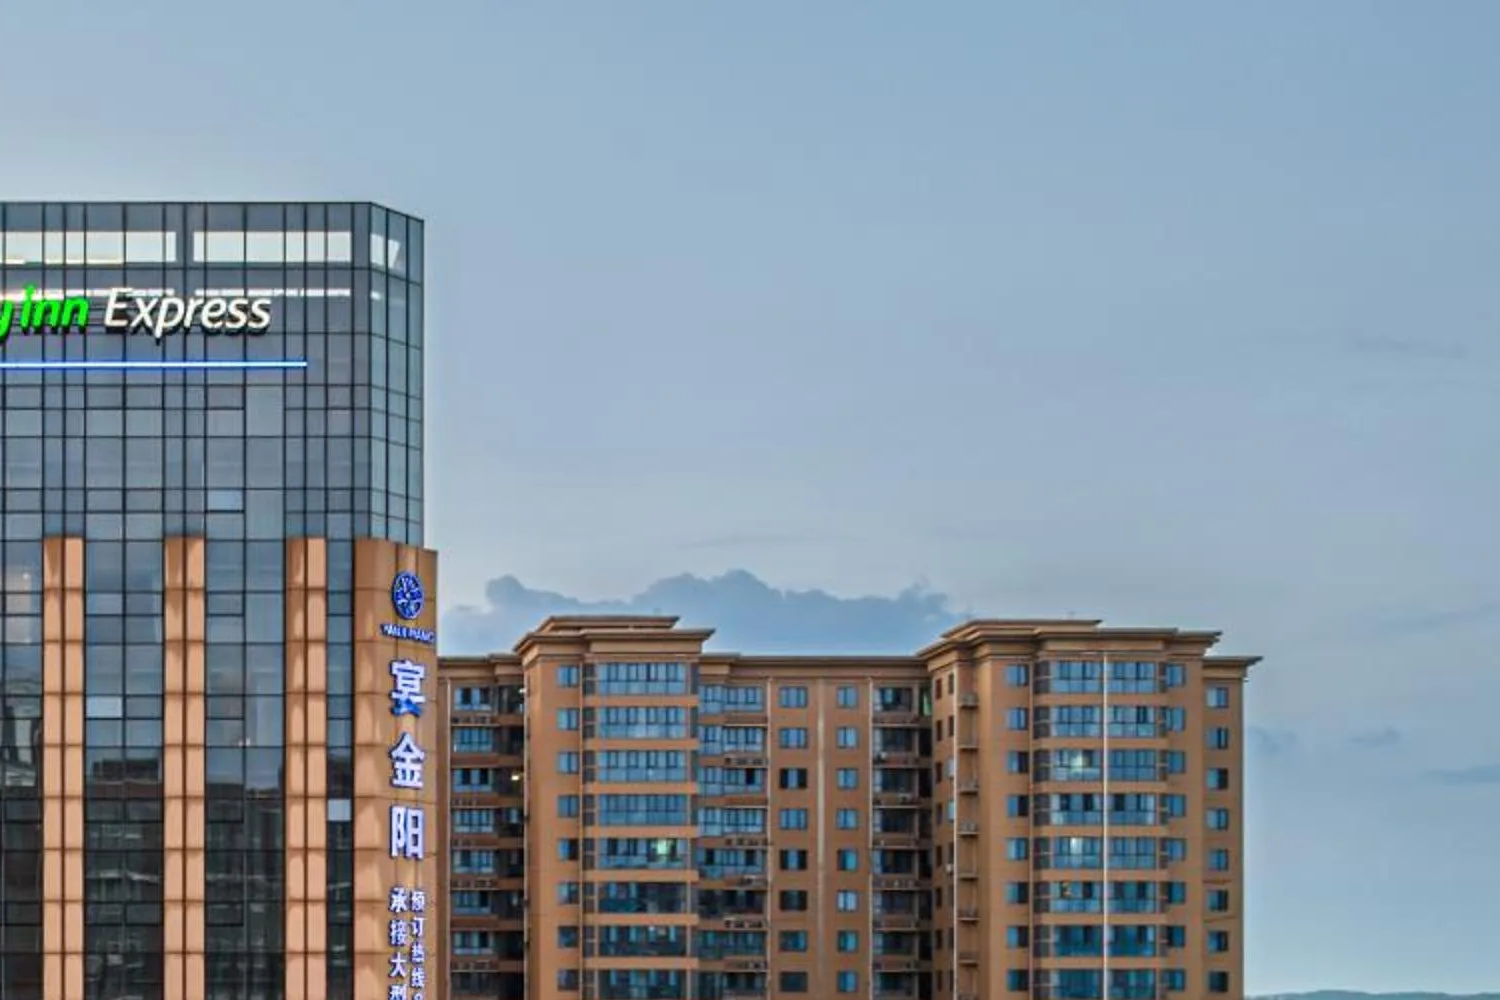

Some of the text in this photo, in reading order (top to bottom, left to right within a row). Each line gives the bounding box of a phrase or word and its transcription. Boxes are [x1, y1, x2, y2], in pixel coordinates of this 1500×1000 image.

[21, 284, 89, 328] Inn
[104, 287, 271, 340] Express
[389, 659, 425, 860] 宴金阳
